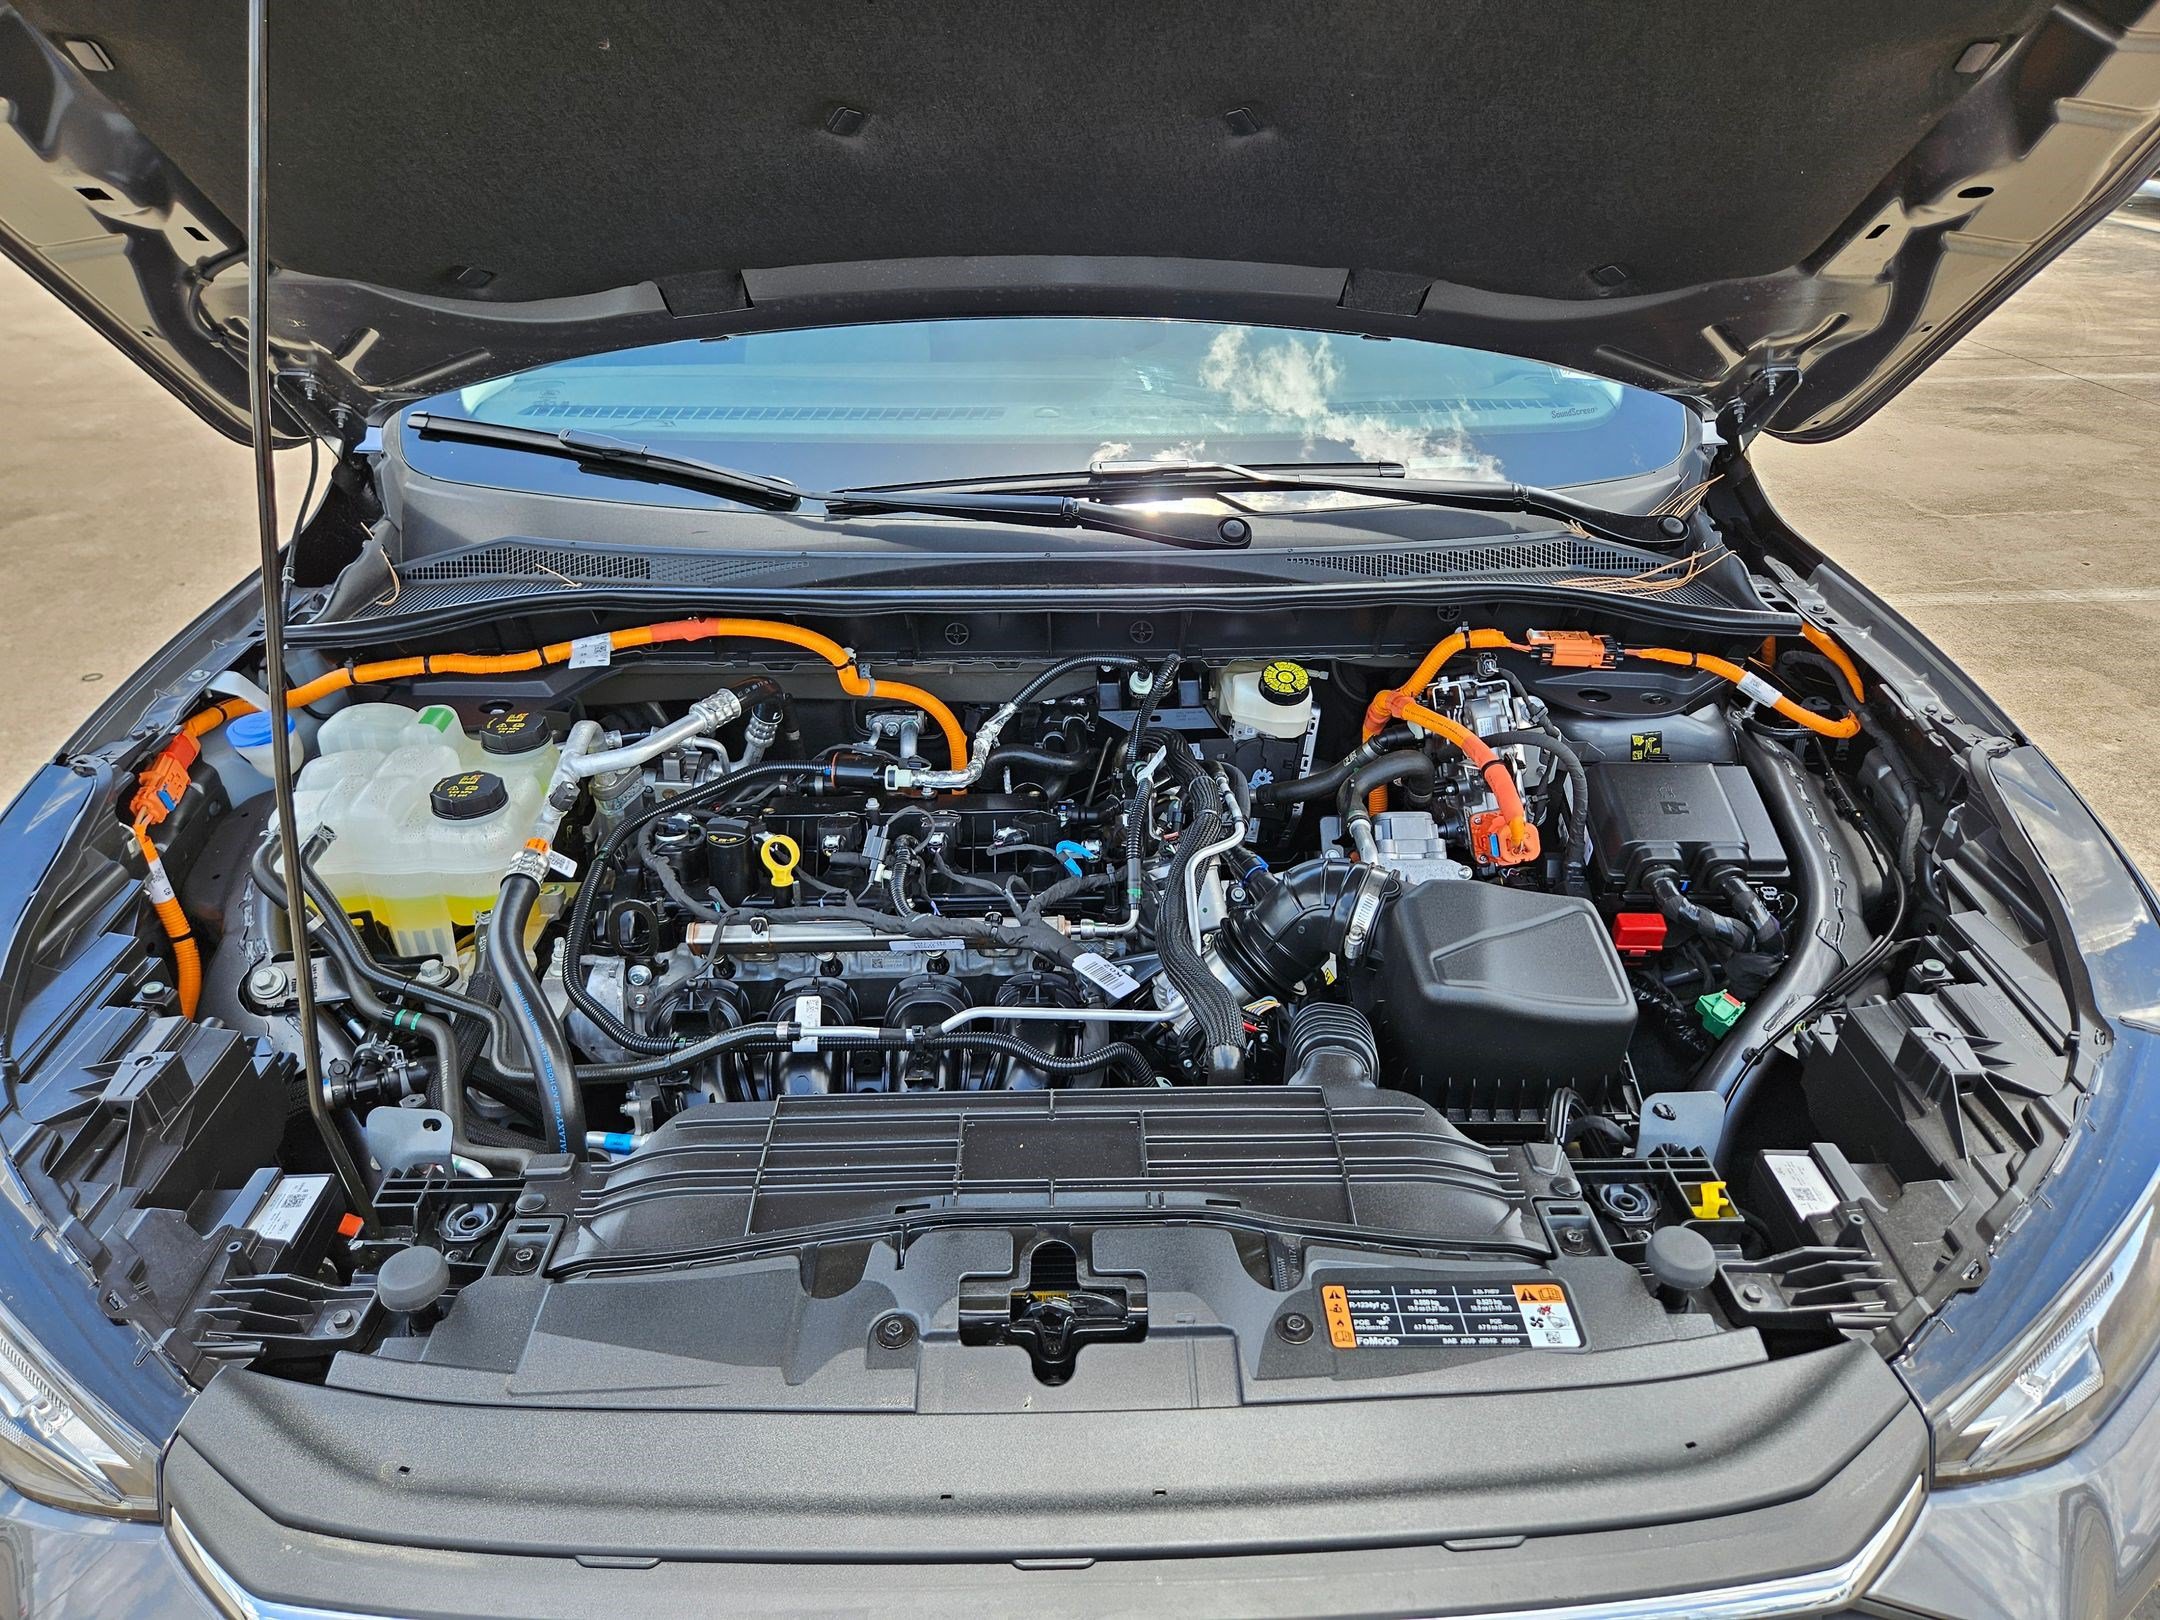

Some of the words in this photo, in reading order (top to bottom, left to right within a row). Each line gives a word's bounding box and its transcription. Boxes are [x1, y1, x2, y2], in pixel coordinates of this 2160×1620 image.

[1551, 407, 1595, 418] SoundScreen
[1349, 1302, 1380, 1310] R-1234yf
[1356, 1336, 1400, 1345] FoMoCo
